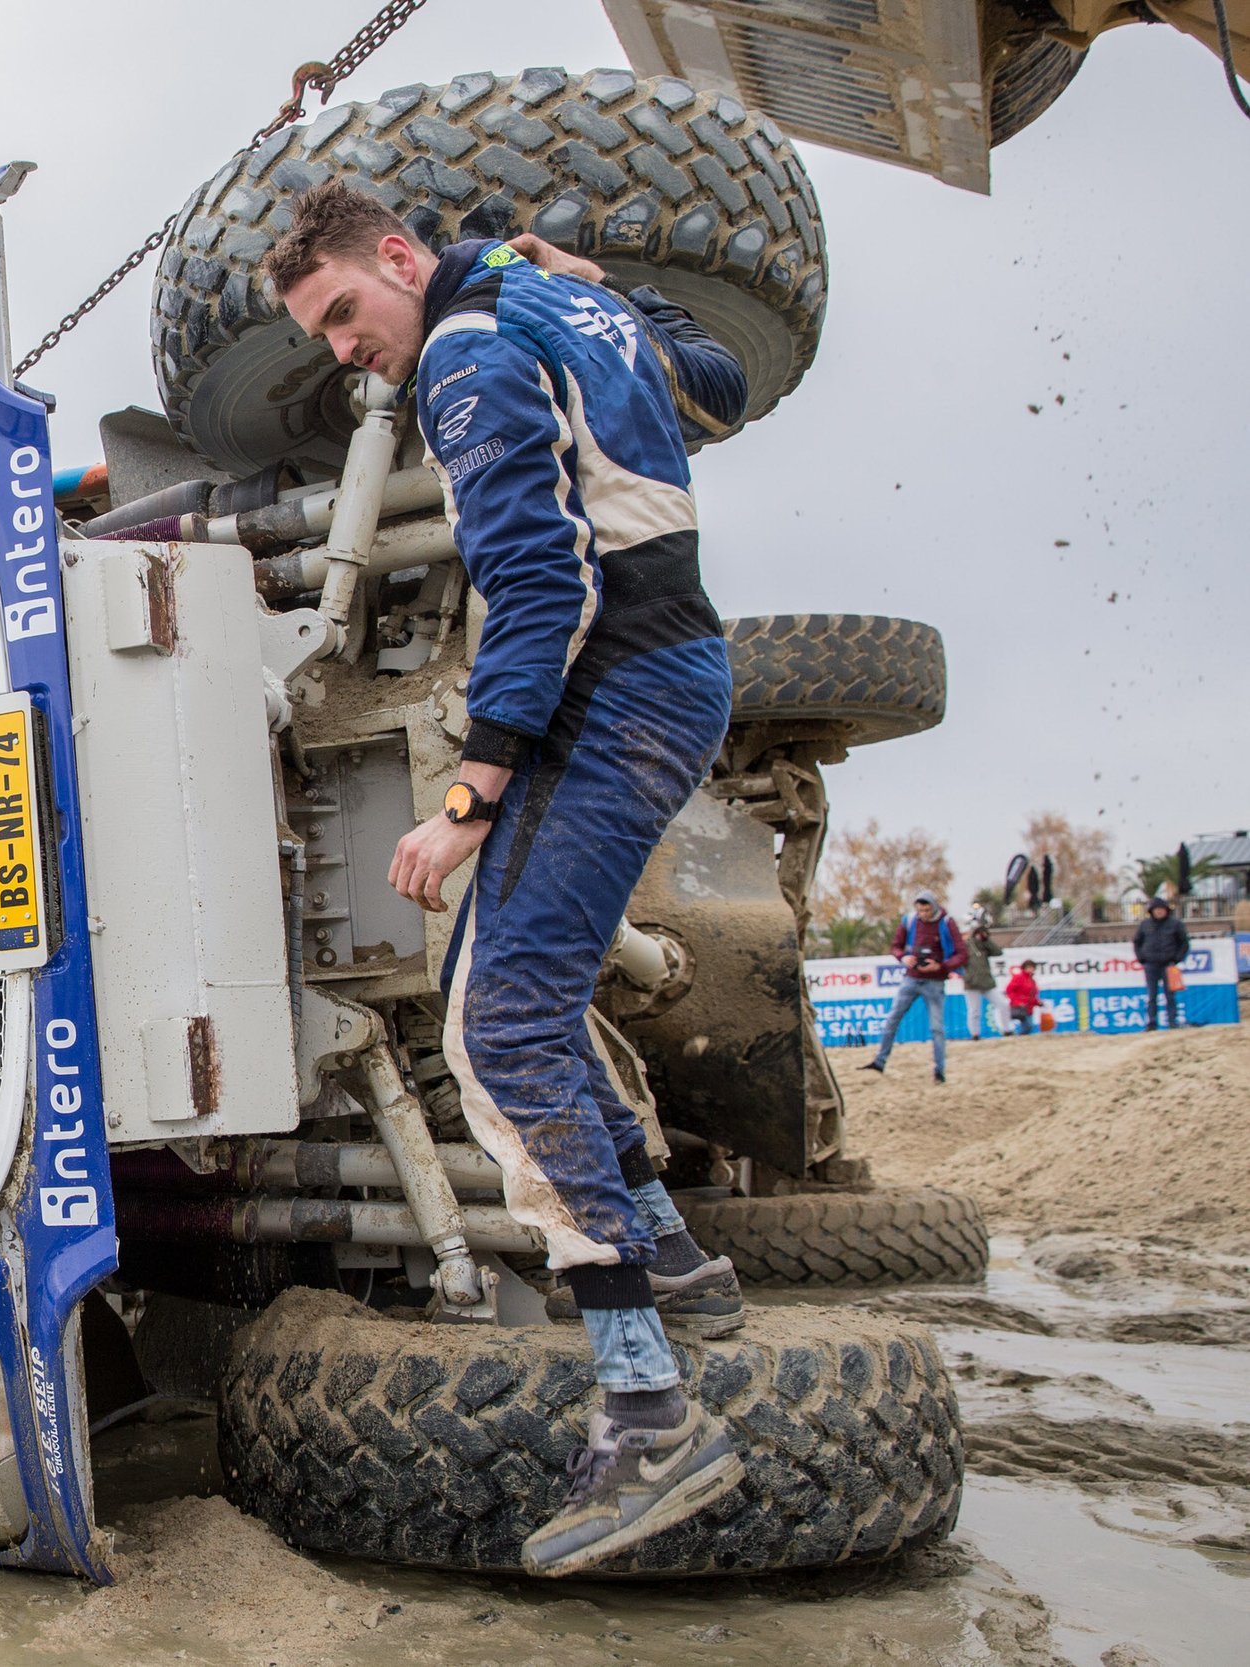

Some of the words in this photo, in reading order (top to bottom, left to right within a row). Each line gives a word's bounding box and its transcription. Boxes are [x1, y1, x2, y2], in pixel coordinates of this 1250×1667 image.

[442, 364, 478, 387] BENELUX
[460, 438, 505, 476] HIAB
[23, 929, 34, 943] NL
[807, 972, 872, 989] kshop
[1091, 994, 1185, 1013] RENTA
[1092, 1013, 1108, 1028] &
[1112, 1008, 1187, 1027] SAES
[31, 1346, 48, 1418] SEIP
[46, 1381, 64, 1475] CHOCOLATERIE
